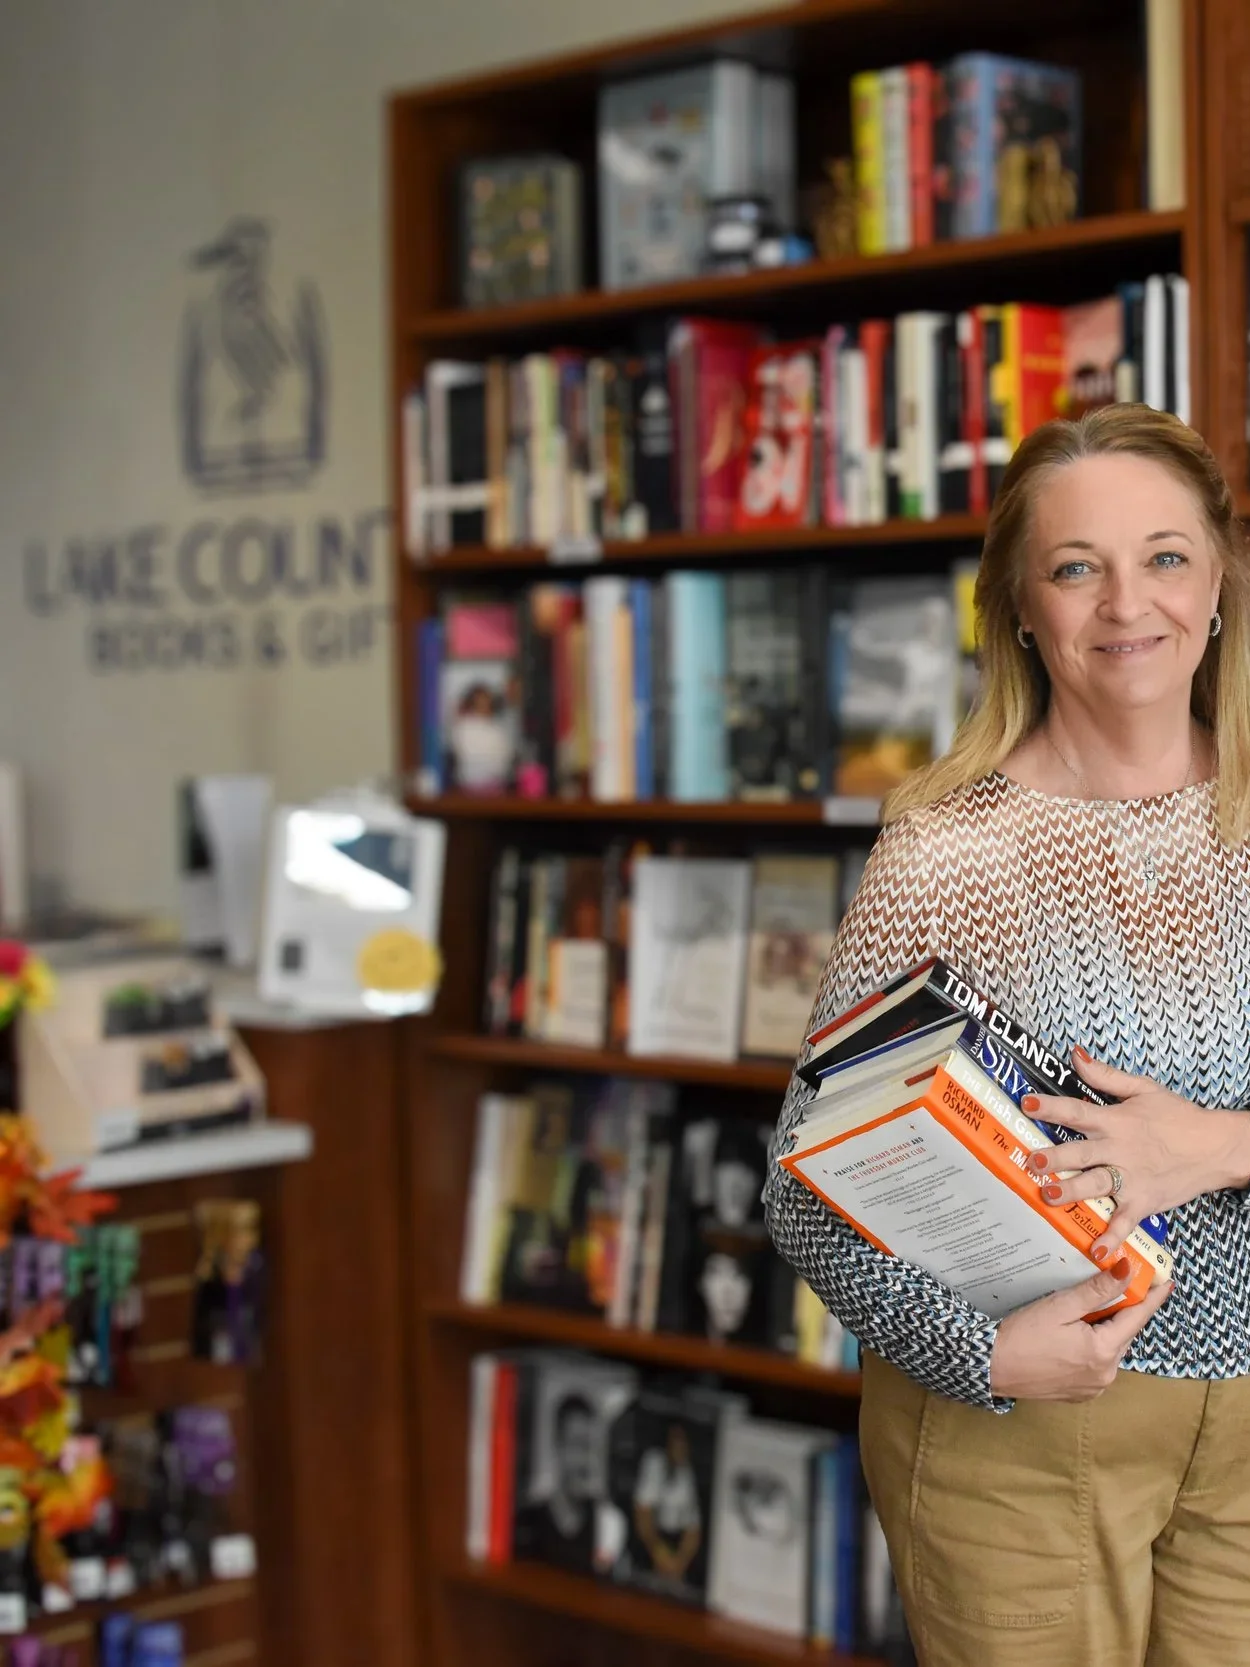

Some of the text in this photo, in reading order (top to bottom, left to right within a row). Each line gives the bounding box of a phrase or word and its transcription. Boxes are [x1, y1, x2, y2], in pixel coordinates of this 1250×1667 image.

[941, 970, 1109, 1107] TOM CLANCY TERMIN
[977, 1035, 1039, 1097] Silv
[942, 1091, 982, 1130] OSMAN
[962, 1069, 982, 1092] THE
[984, 1084, 1013, 1122] Irish
[833, 1136, 924, 1178] PRAISE FOR RICHARD OSMAN AND
[992, 1128, 1011, 1155] The
[848, 1146, 927, 1182] THE THURSDAY MURDER CLUB
